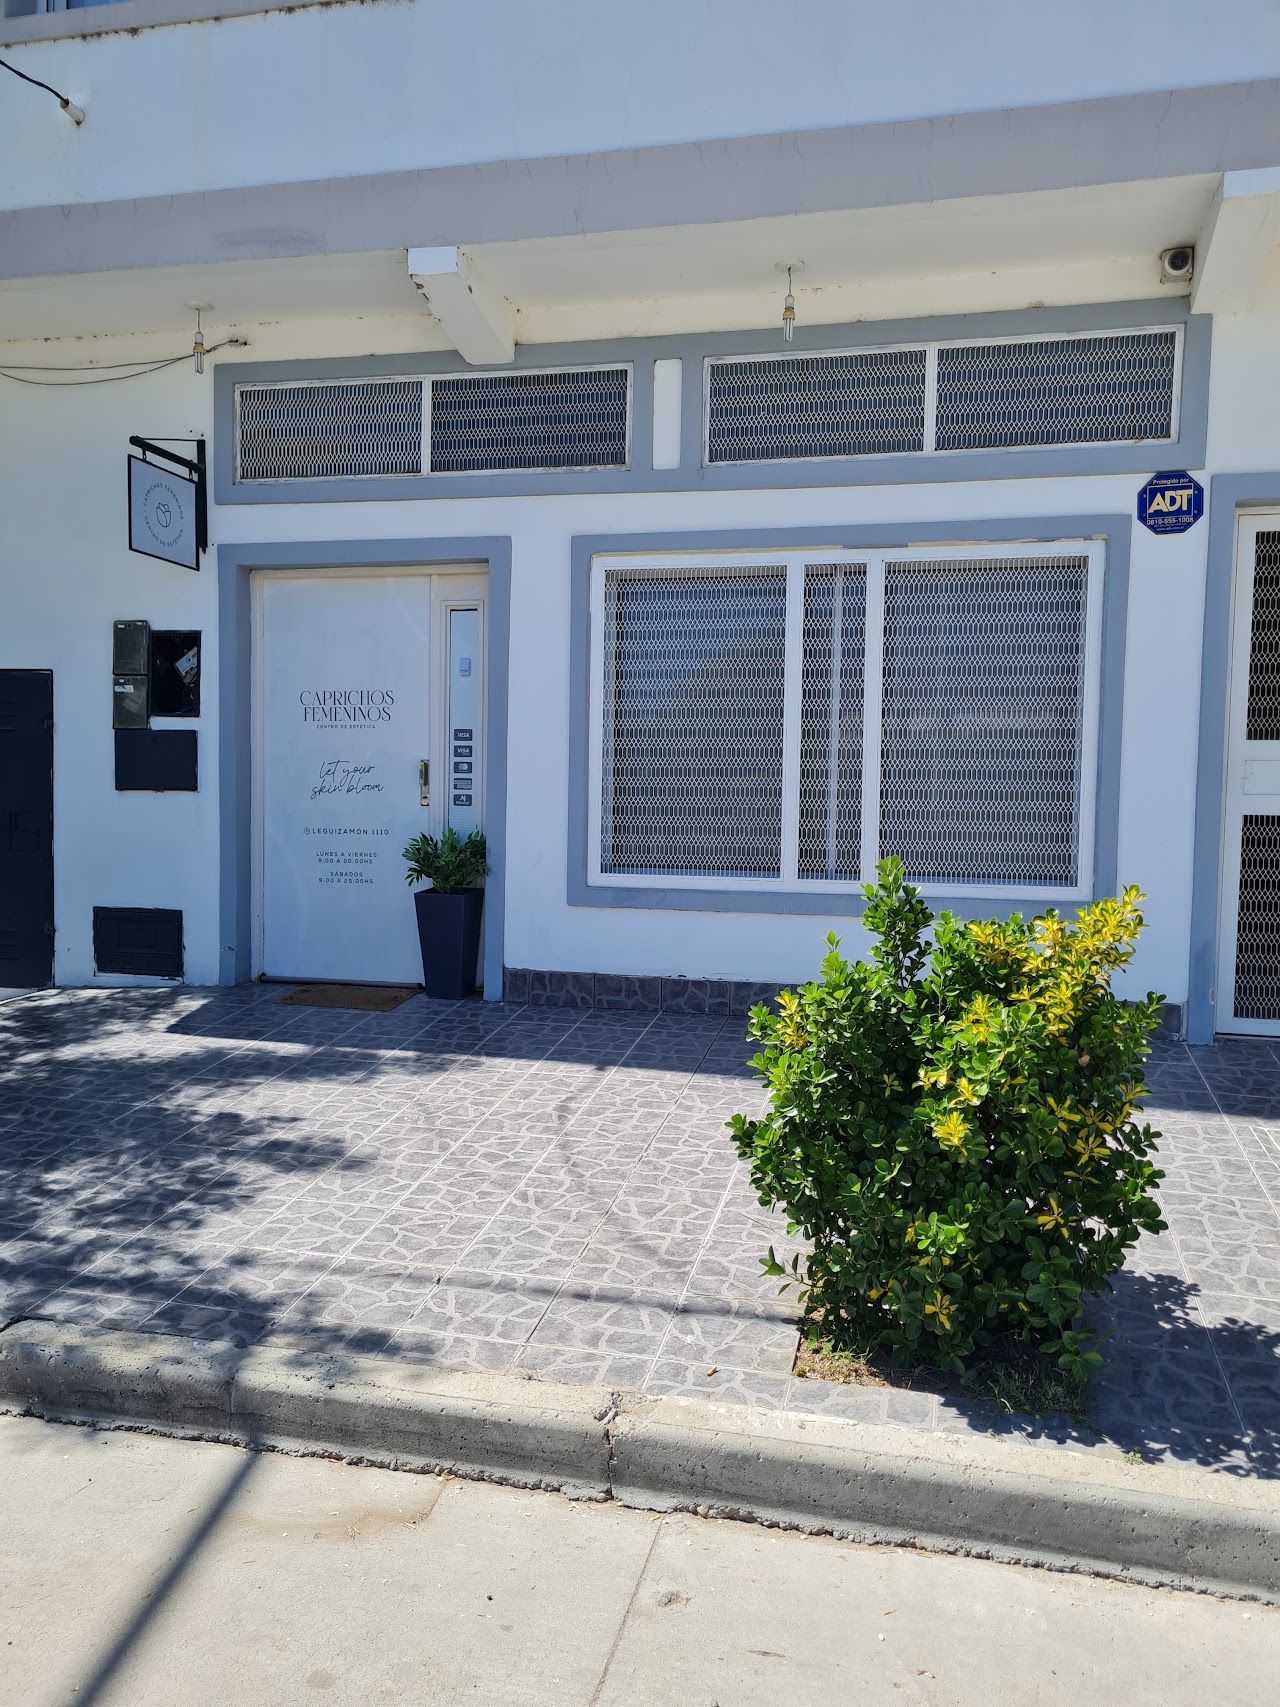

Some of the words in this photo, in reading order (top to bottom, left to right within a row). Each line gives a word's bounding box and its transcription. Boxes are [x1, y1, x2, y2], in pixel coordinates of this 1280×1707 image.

[143, 482, 163, 506] CAPRICHOS
[164, 484, 184, 520] FEMENINOS
[1148, 489, 1192, 513] ADT
[144, 516, 159, 541] CENTRO
[1147, 517, 1194, 525] 0810-555-1008
[300, 690, 394, 706] CAPRICHOS
[304, 706, 391, 722] FEMENINOS
[320, 760, 350, 783] let
[340, 766, 375, 787] your
[310, 778, 342, 800] skin
[346, 774, 384, 794] bloom
